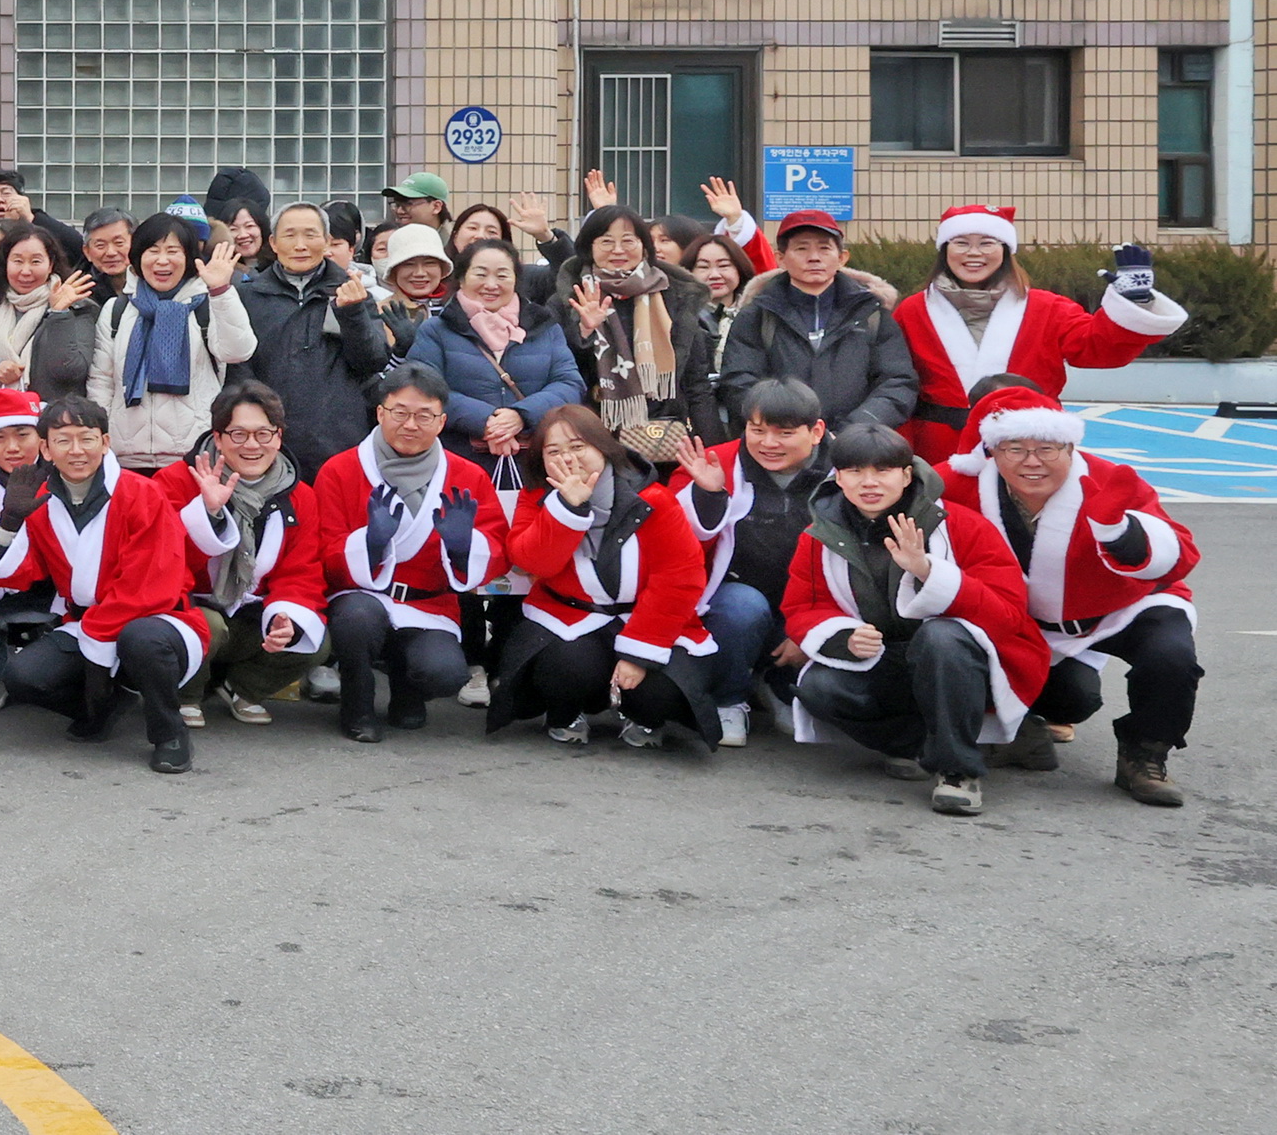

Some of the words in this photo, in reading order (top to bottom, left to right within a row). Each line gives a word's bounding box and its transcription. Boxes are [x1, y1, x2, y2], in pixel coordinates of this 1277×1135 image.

[452, 128, 496, 146] 2932
[770, 148, 811, 158] 장애인전용
[813, 148, 848, 158] 주차구역
[785, 164, 807, 192] P
